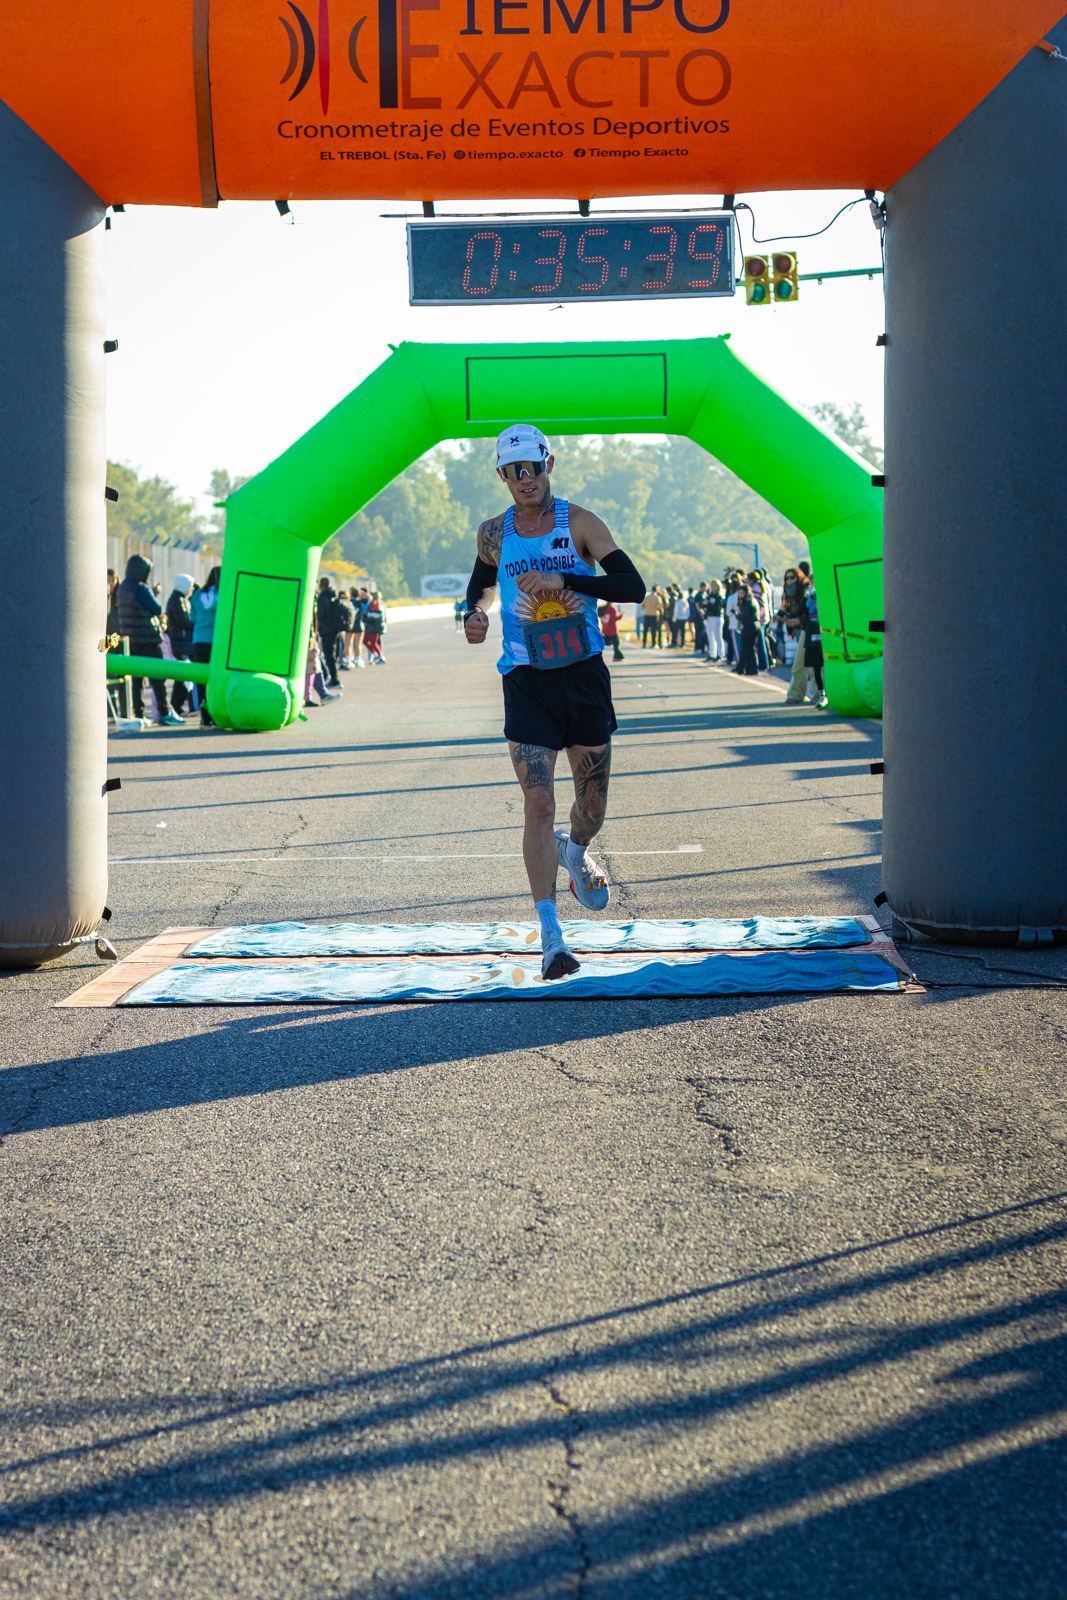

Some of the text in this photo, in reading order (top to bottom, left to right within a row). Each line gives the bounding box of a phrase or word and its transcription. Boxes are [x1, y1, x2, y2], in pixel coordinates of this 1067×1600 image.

[277, 116, 730, 142] Cronometraje de Eventos Deportivos
[320, 147, 689, 161] EL TREBOL (Sta. Fe) tiempo.exacto Tiempo Exacto
[504, 559, 529, 579] TODO
[529, 557, 540, 570] ES
[540, 554, 576, 572] POSIBLE
[539, 627, 583, 660] 314
